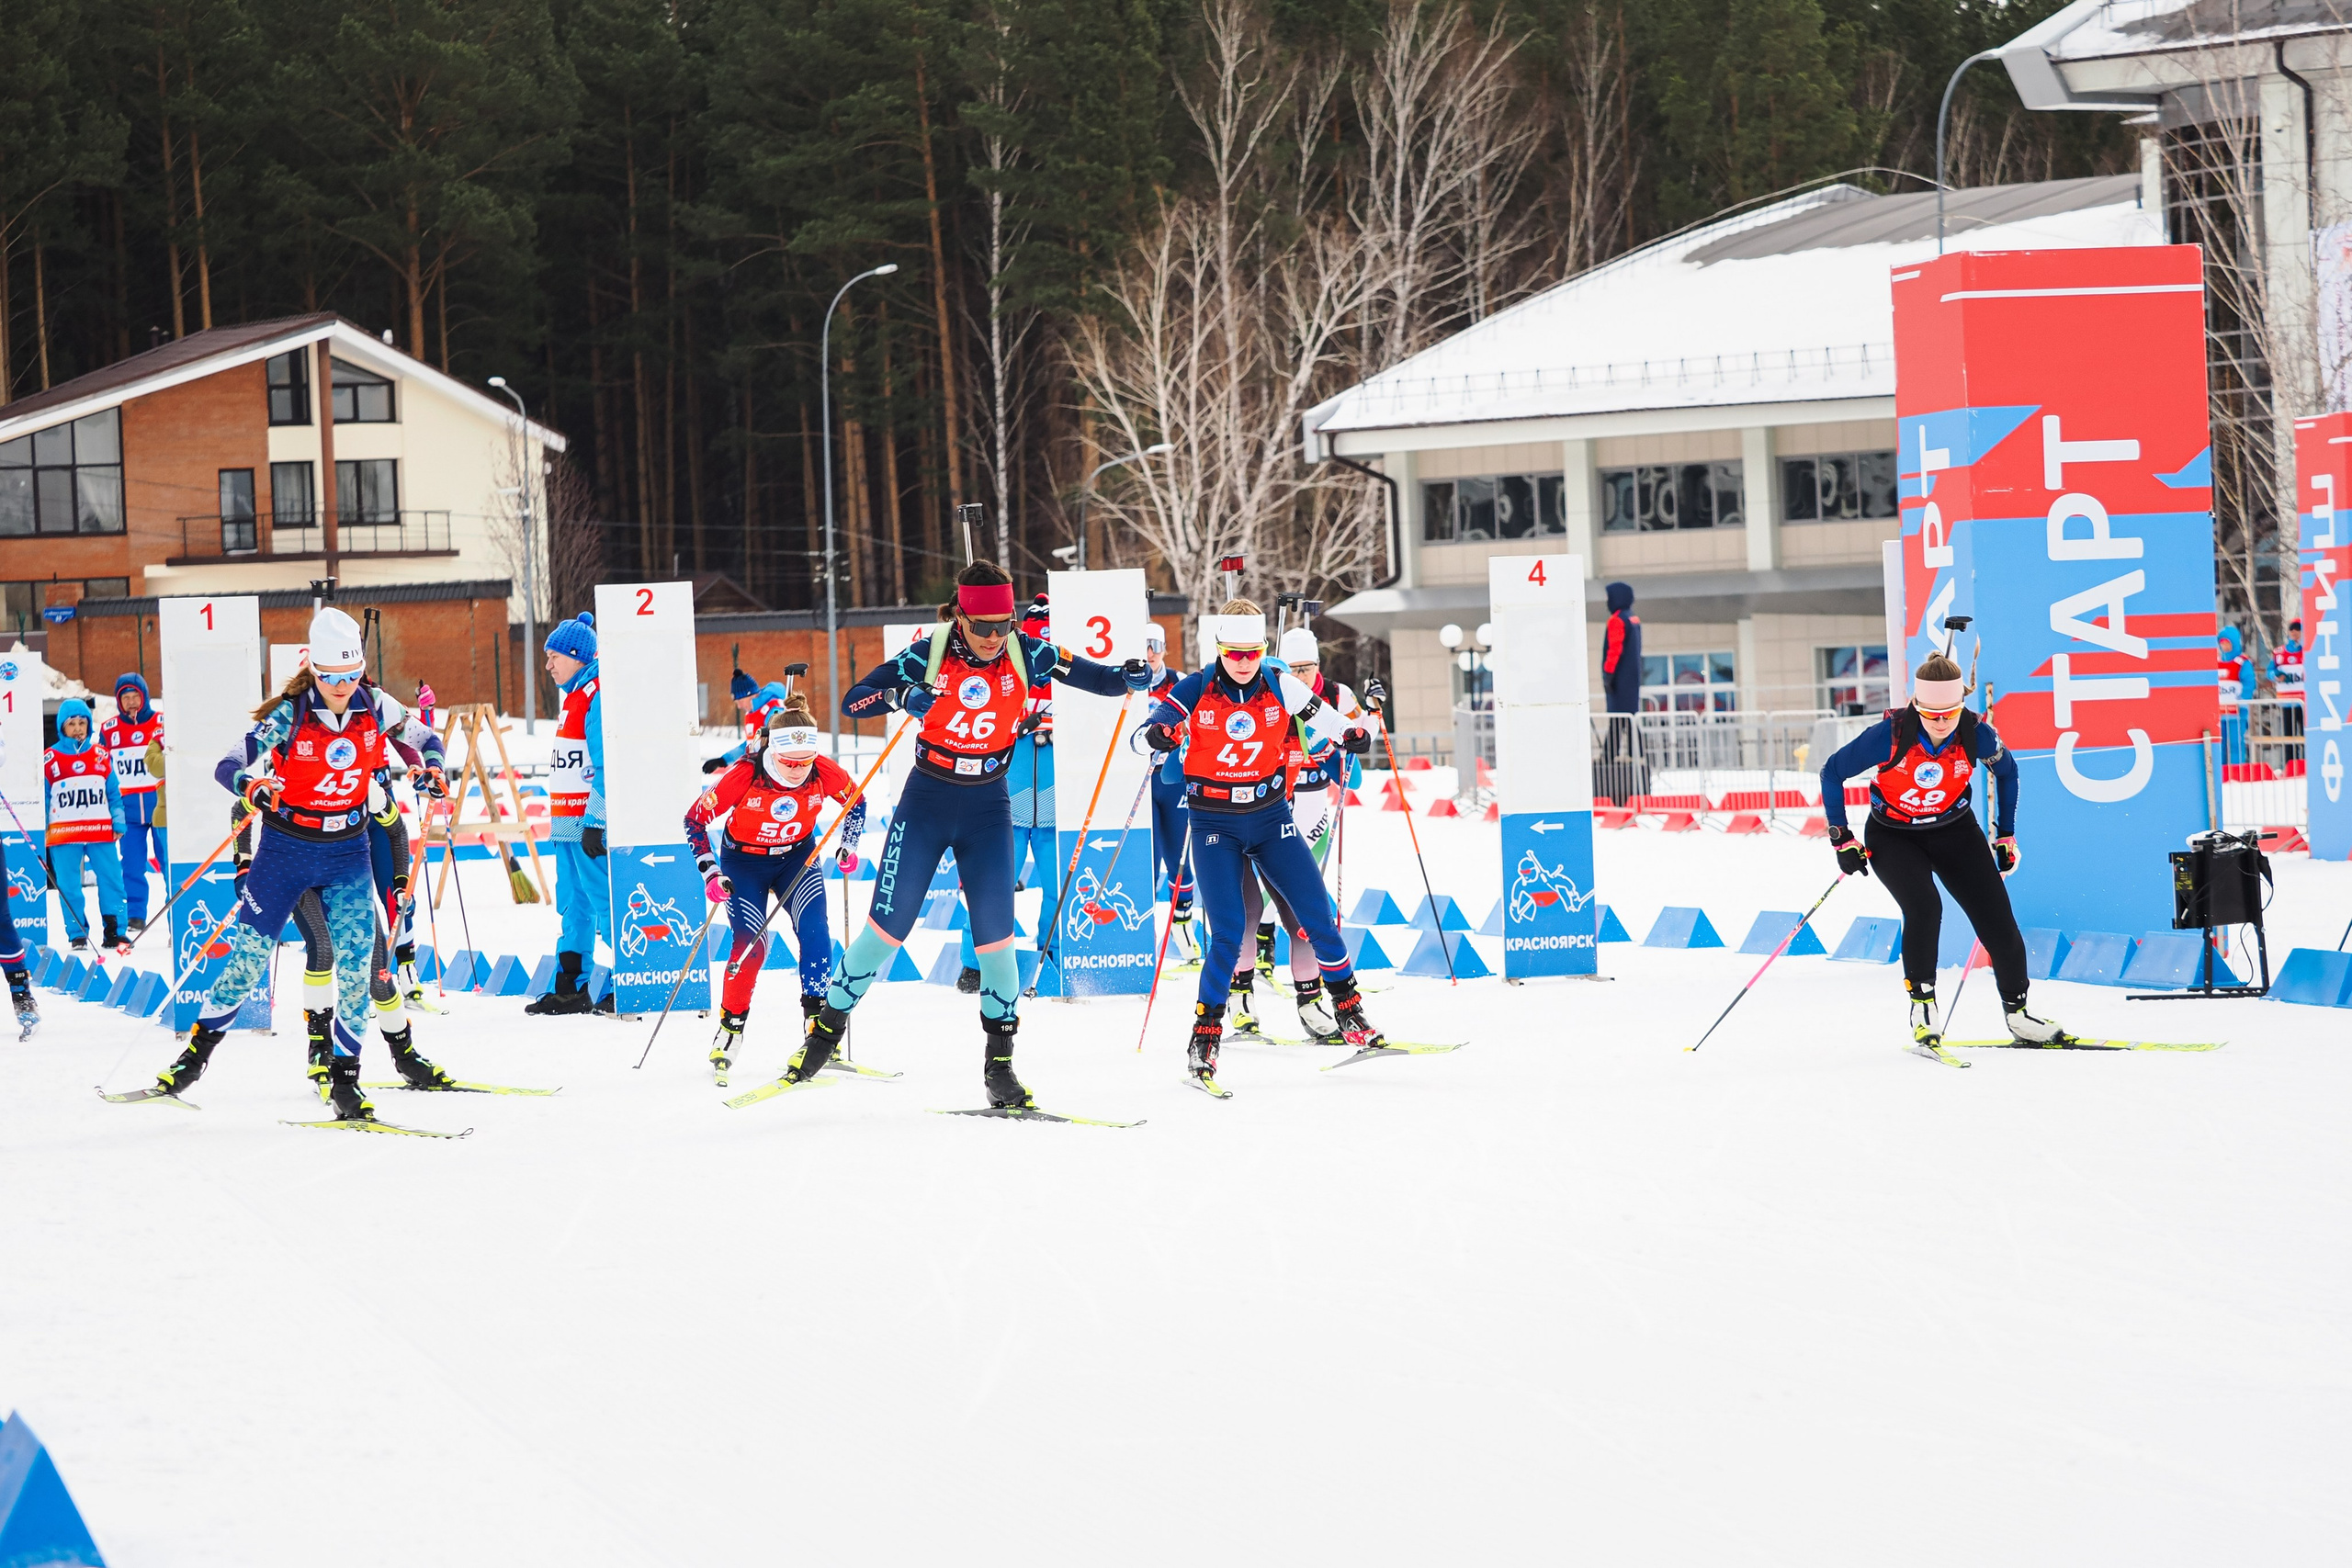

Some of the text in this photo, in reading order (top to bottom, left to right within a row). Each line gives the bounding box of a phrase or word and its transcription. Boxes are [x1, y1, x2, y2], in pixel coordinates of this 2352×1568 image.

[1918, 424, 1957, 663] АРТ
[1528, 559, 1546, 586] 4
[636, 588, 654, 615] 2
[2041, 415, 2154, 803] СТАРТ
[200, 603, 213, 630] 1
[1085, 615, 1114, 659] 3
[2311, 474, 2344, 803] ФИНИШ
[2, 691, 13, 713] 1
[945, 711, 997, 740] 46
[944, 739, 989, 750] КРАСНОЯРСК
[1216, 741, 1263, 768] 47
[117, 759, 148, 776] СУД
[550, 750, 583, 772] ДЬЯ
[313, 769, 363, 796] 45
[1216, 770, 1260, 778] КРАСНОЯРСК
[1899, 788, 1946, 807] 49
[758, 822, 802, 838] 50
[13, 917, 47, 929] ОЯРСК
[1507, 934, 1595, 952] КРАСНОЯРСК
[1064, 953, 1154, 970] КРАСНОЯРСК
[616, 969, 708, 987] КРАСНОЯРСК
[1301, 982, 1314, 990] 201
[175, 987, 269, 1004] КРАССК
[395, 1032, 407, 1041] 199
